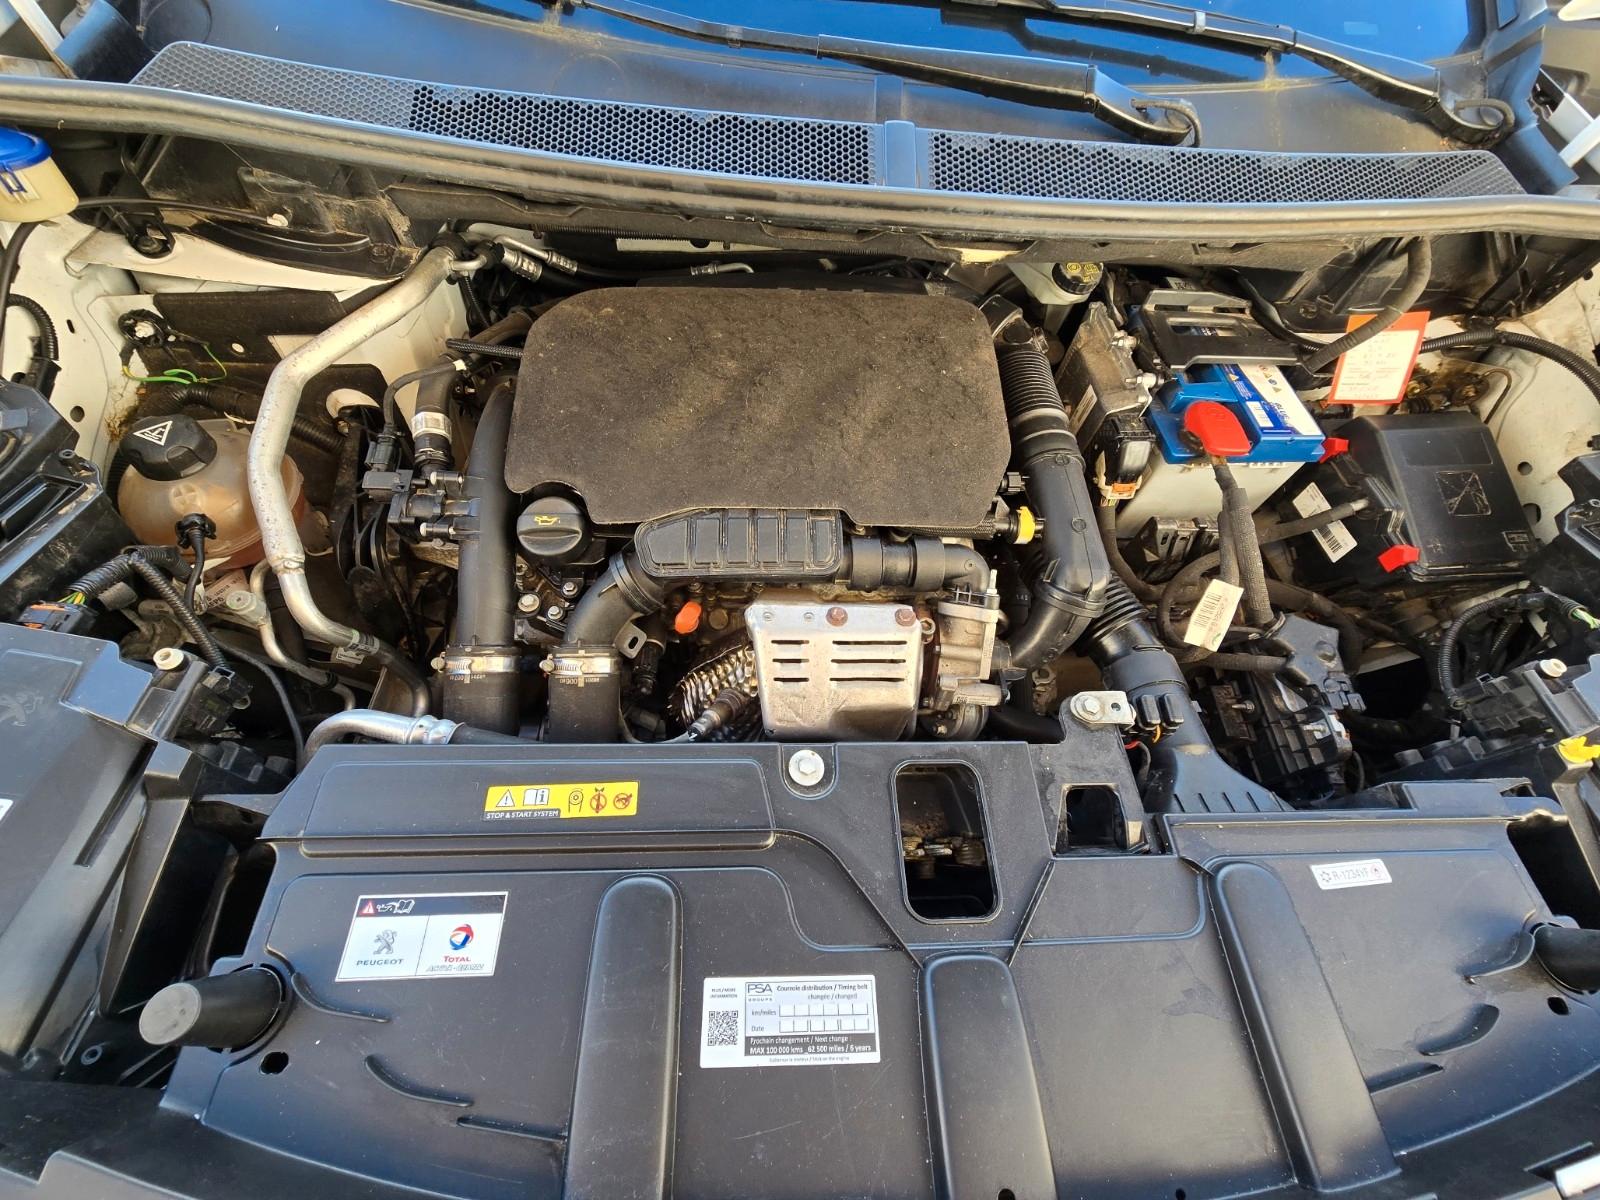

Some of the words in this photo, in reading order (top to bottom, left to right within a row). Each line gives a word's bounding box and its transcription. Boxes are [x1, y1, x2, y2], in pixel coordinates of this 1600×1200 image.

[356, 958, 404, 966] PEUGEOT
[443, 955, 471, 963] TOTAL
[747, 983, 773, 994] PSA
[750, 1037, 775, 1045] Prochain
[775, 1036, 809, 1045] changement
[828, 1035, 849, 1043] change
[749, 1047, 765, 1055] MAX
[778, 1046, 790, 1054] 000
[828, 1044, 844, 1052] miles
[855, 1044, 872, 1052] years
